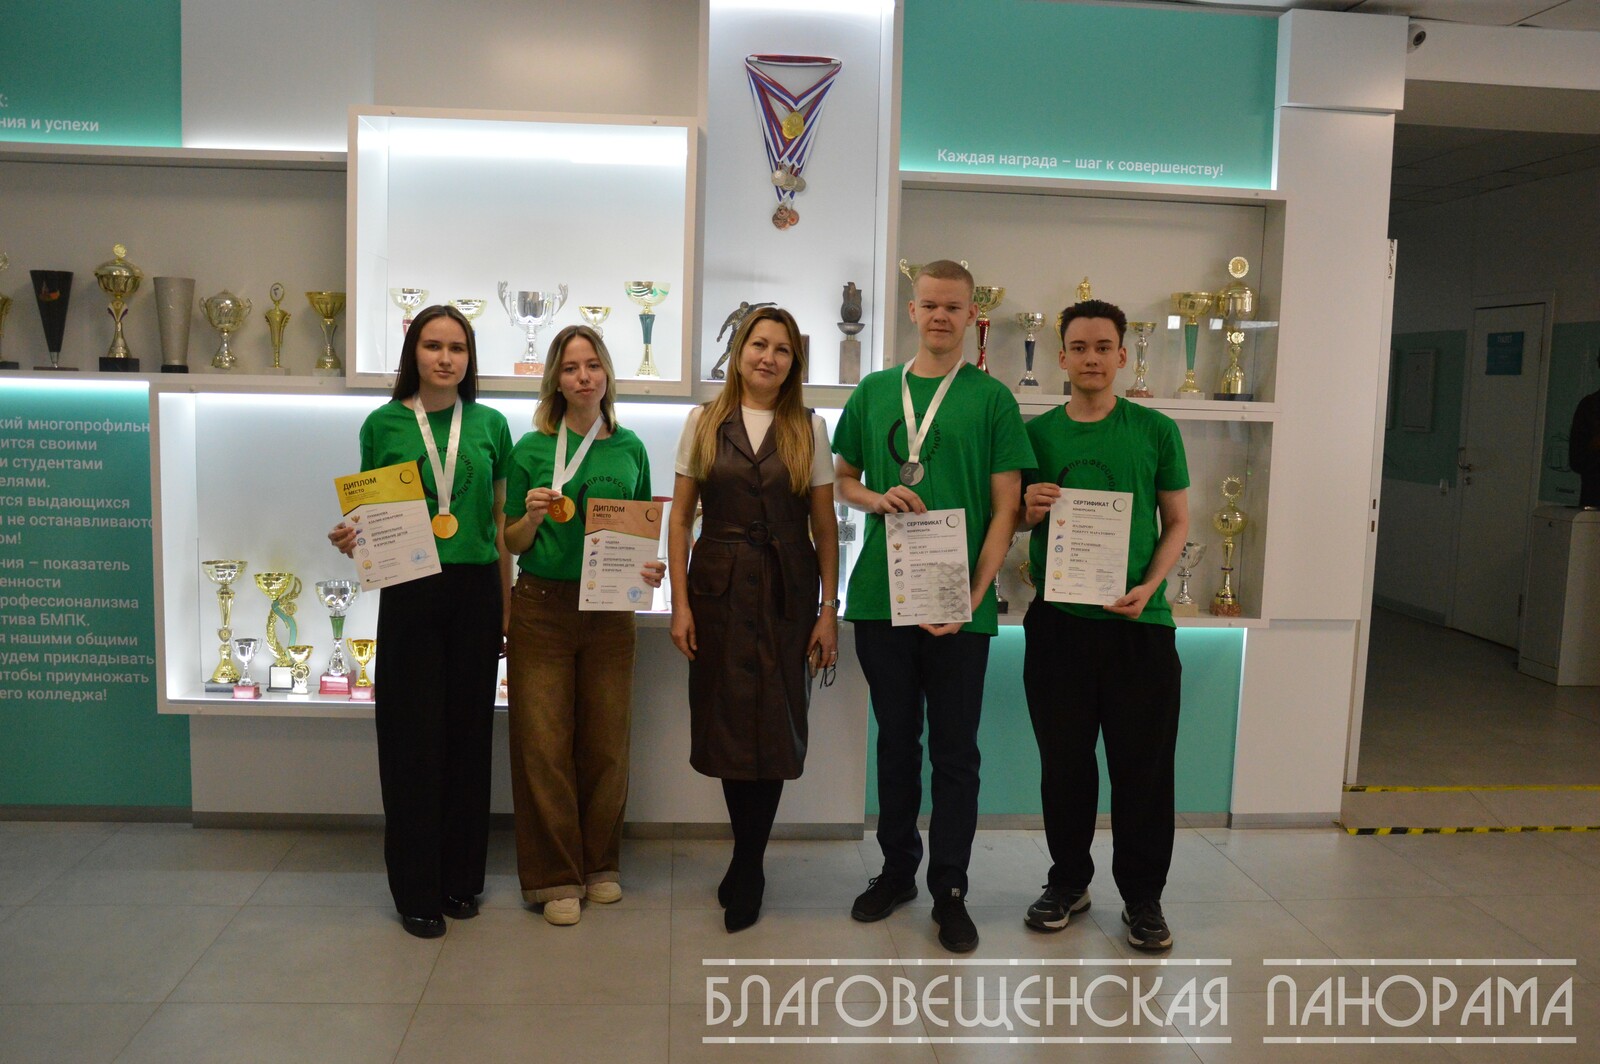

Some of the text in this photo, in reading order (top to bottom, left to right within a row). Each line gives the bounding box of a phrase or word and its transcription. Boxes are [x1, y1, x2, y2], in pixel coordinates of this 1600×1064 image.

[31, 118, 41, 129] и
[45, 119, 99, 133] успехи
[937, 149, 995, 166] Каждая
[999, 153, 1057, 169] награда
[1075, 157, 1101, 169] шаг
[1106, 159, 1114, 170] к
[1118, 160, 1224, 179] совершенству!
[0, 438, 97, 451] ится своими
[12, 458, 103, 471] студентами
[904, 466, 912, 476] 2
[343, 477, 377, 491] ДИПЛОМ
[349, 488, 365, 496] МЕСТО
[28, 497, 130, 510] выдающихся
[553, 503, 561, 514] 3
[592, 504, 625, 513] ДИПЛОМ
[1073, 499, 1109, 507] СЕРТИФИКАТ
[7, 515, 26, 526] не
[906, 519, 942, 527] СЕРТИФИКАТ
[43, 559, 130, 571] показатель
[0, 594, 139, 609] рофессионализма
[1, 613, 90, 627] тива БМПК.
[10, 634, 72, 645] нашими
[76, 632, 138, 647] общими
[0, 652, 155, 667] удем прикладывать
[46, 671, 150, 684] приумножать
[27, 688, 108, 702] колледжа!
